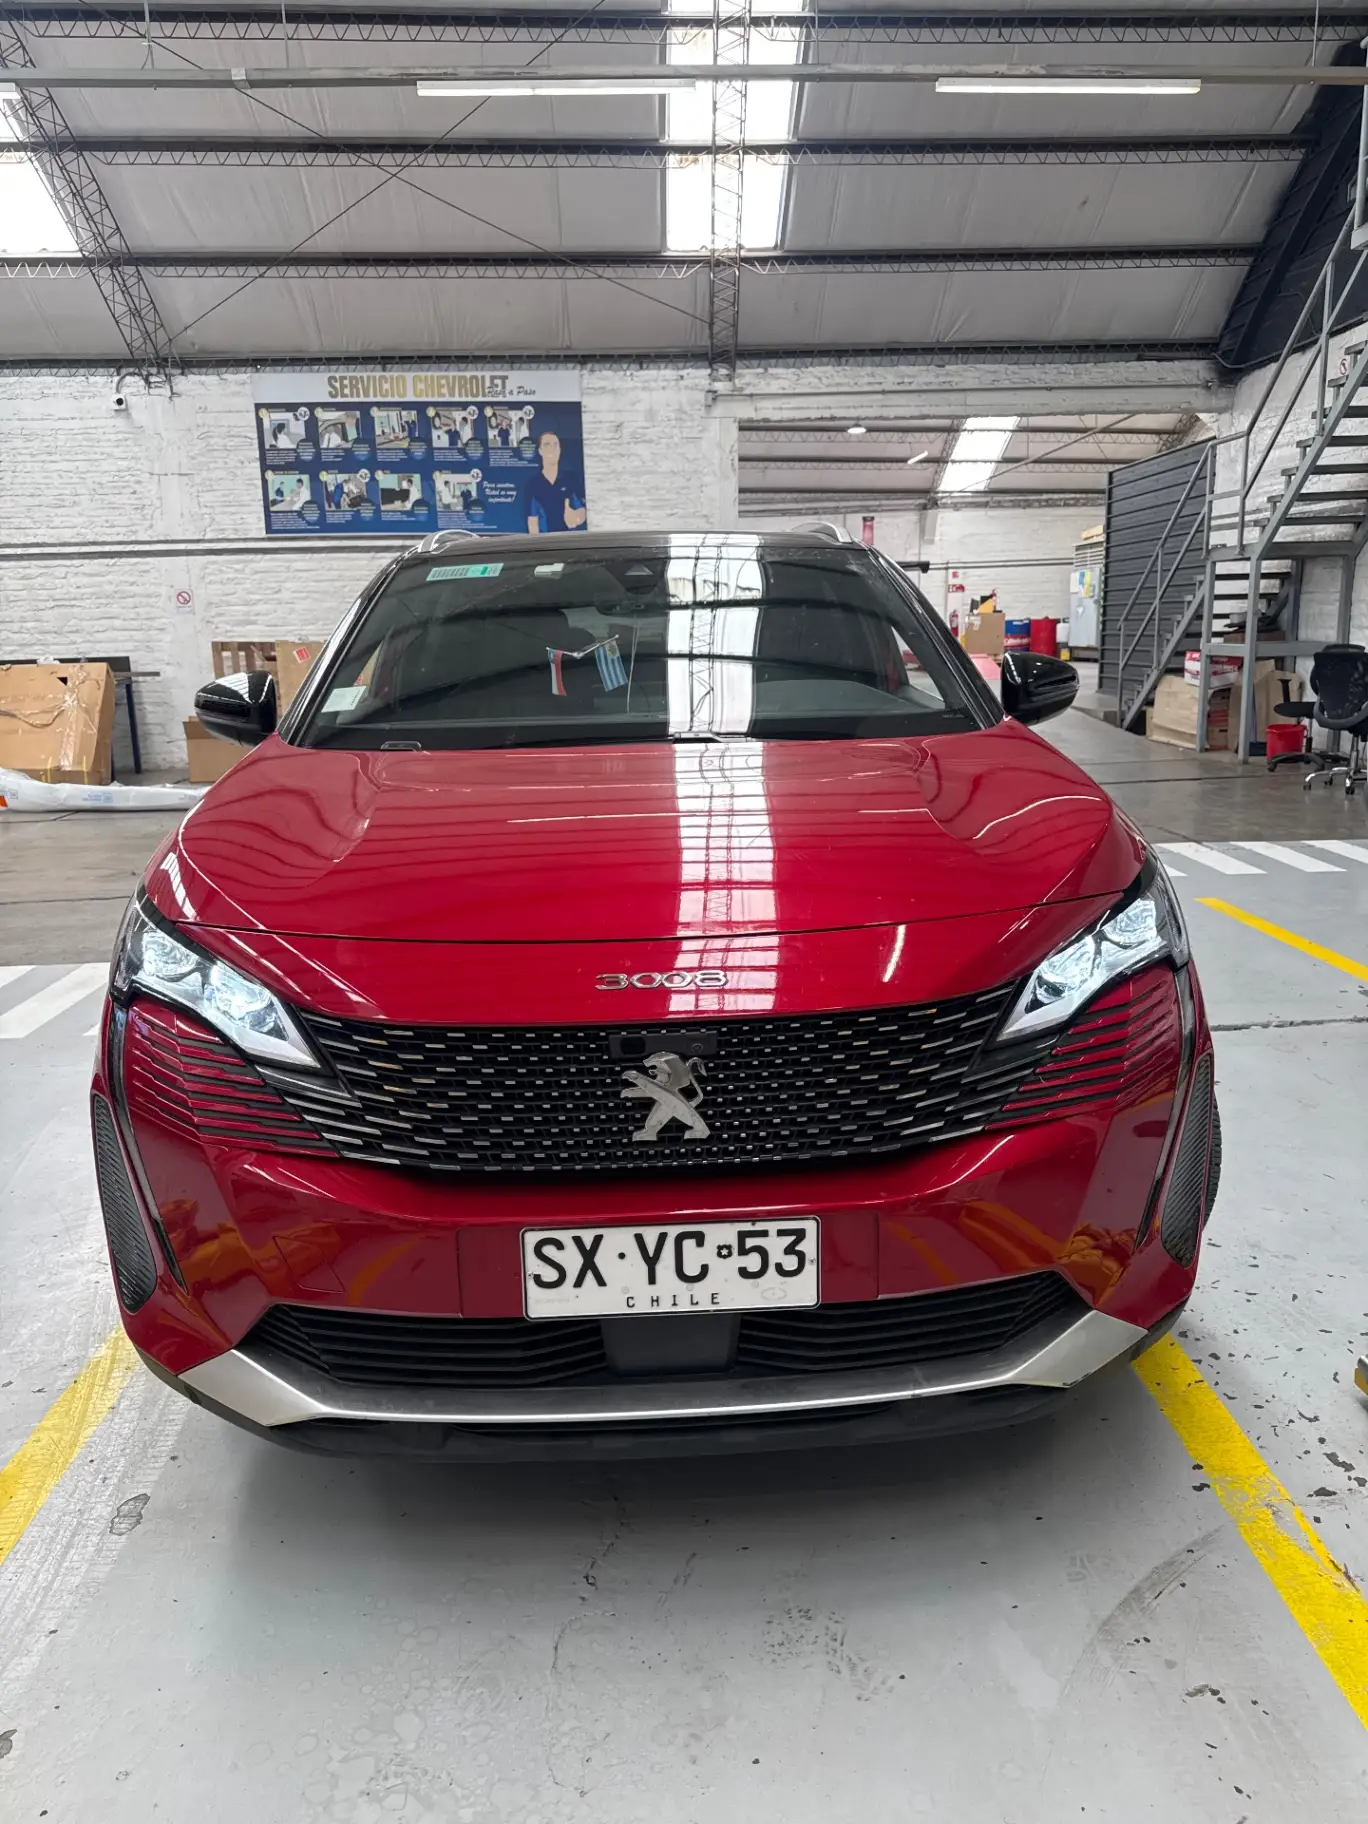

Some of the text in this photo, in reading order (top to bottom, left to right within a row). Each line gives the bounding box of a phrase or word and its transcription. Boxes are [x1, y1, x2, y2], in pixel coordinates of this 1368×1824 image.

[327, 375, 509, 399] SERVICIO CHEVROLET
[516, 385, 536, 397] Paso
[595, 970, 729, 991] 3008
[626, 1292, 721, 1308] CHILE
